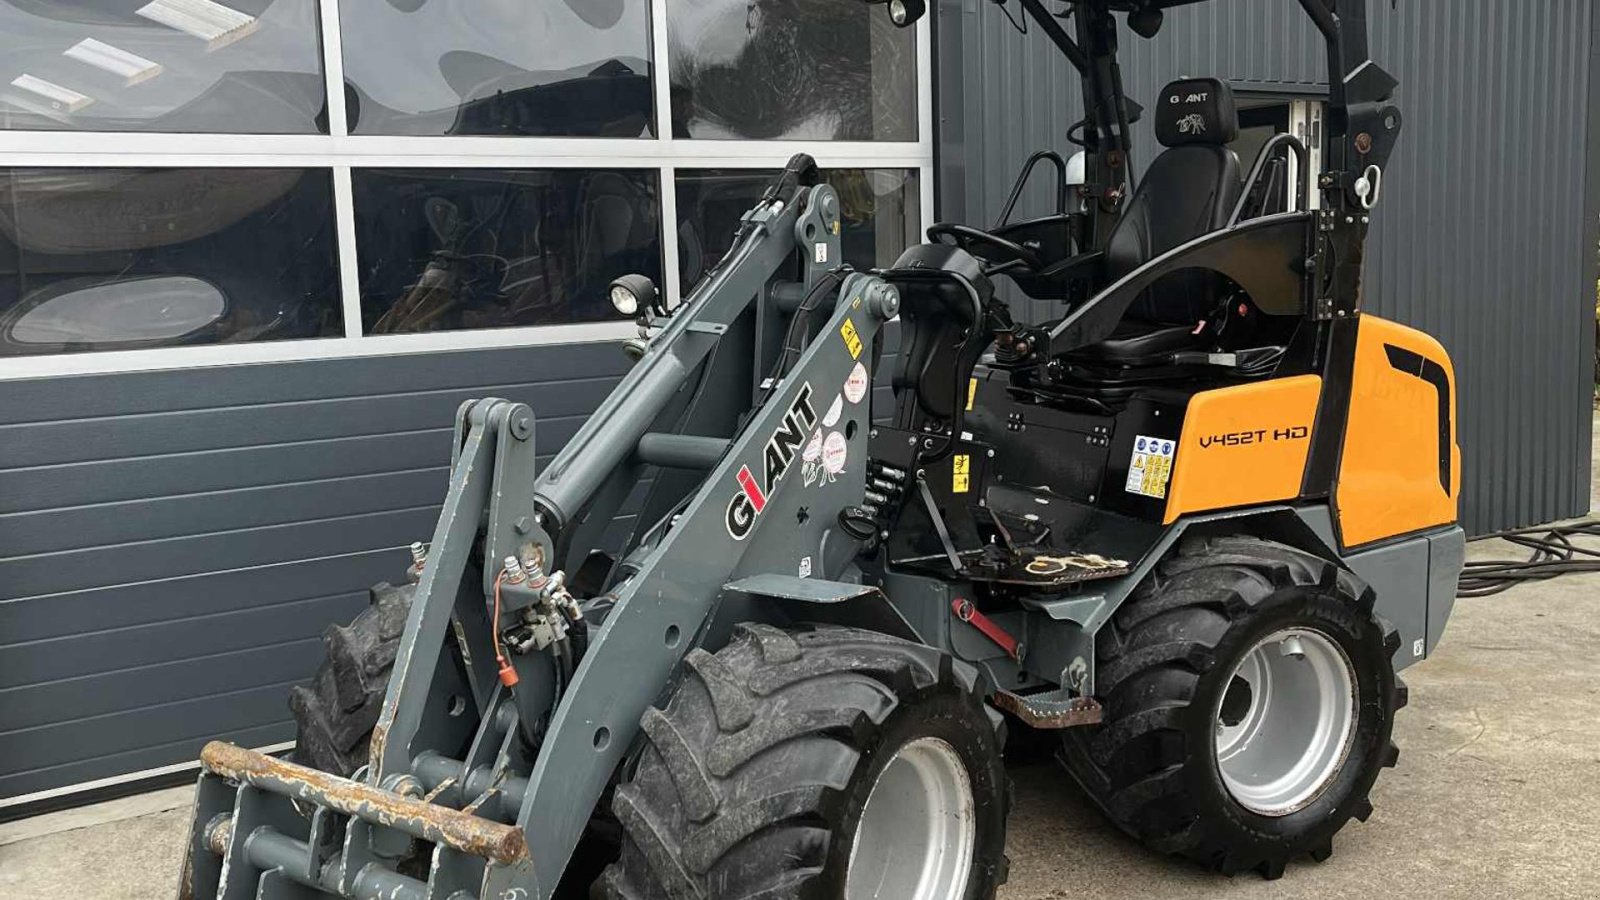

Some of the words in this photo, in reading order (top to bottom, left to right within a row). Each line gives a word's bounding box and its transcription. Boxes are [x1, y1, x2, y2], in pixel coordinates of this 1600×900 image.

[1170, 92, 1208, 104] GANT
[1199, 430, 1267, 448] V452T
[1273, 426, 1308, 441] HD
